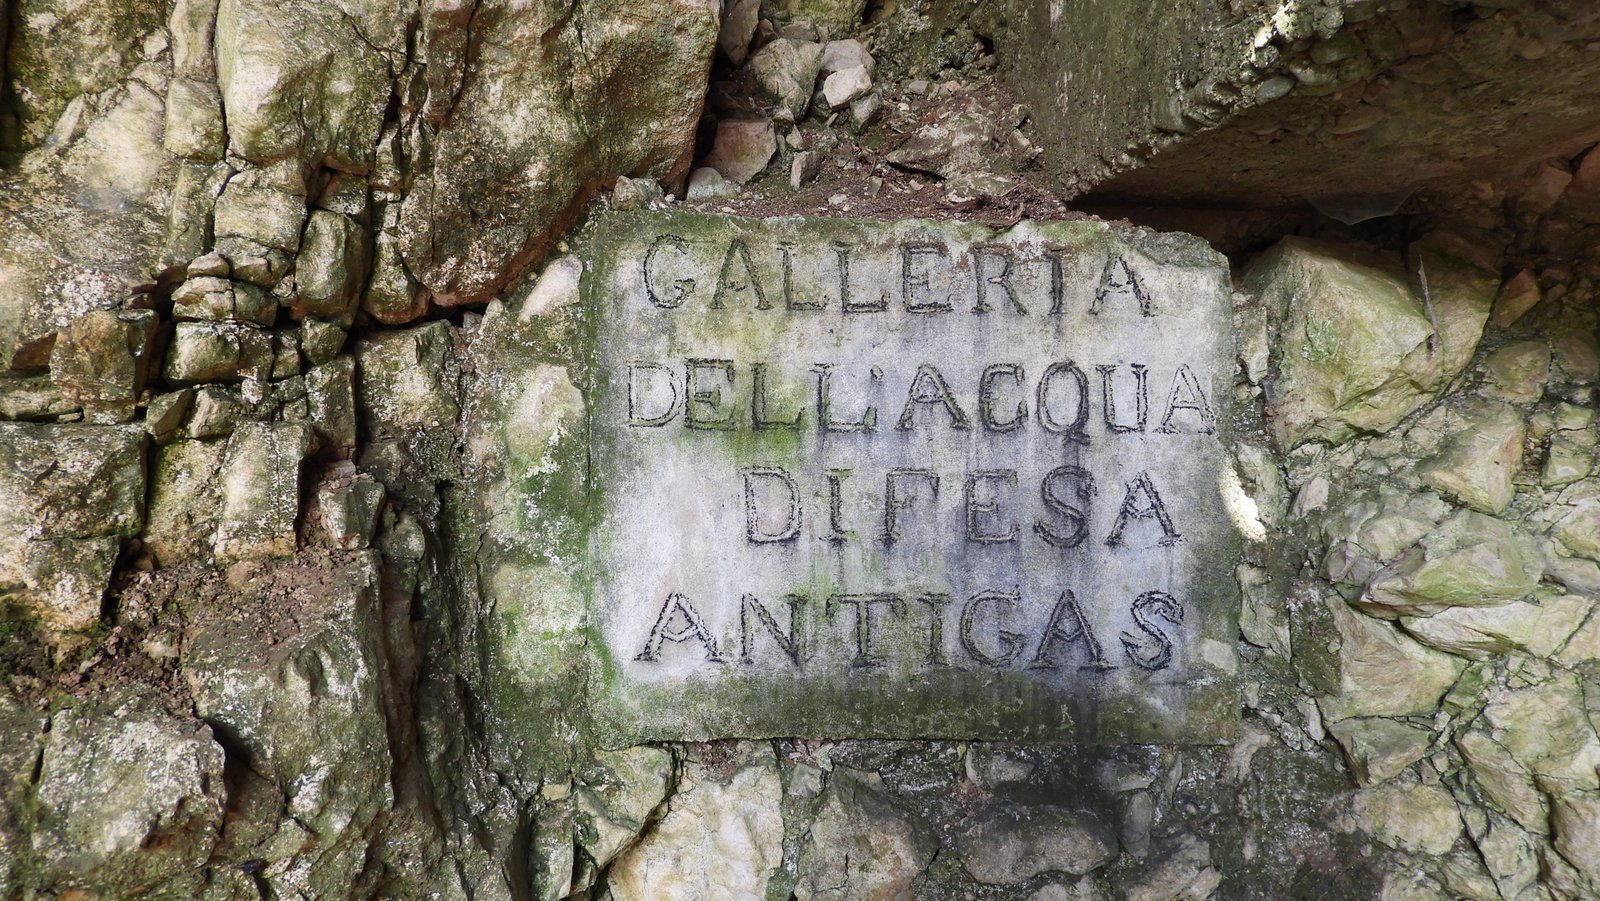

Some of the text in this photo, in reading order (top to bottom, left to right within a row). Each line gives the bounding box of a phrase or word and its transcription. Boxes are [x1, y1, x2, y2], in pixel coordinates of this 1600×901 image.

[643, 233, 1158, 318] GALLERIA
[739, 464, 1189, 550] DIFESA
[633, 584, 1184, 671] ANTIGAS
